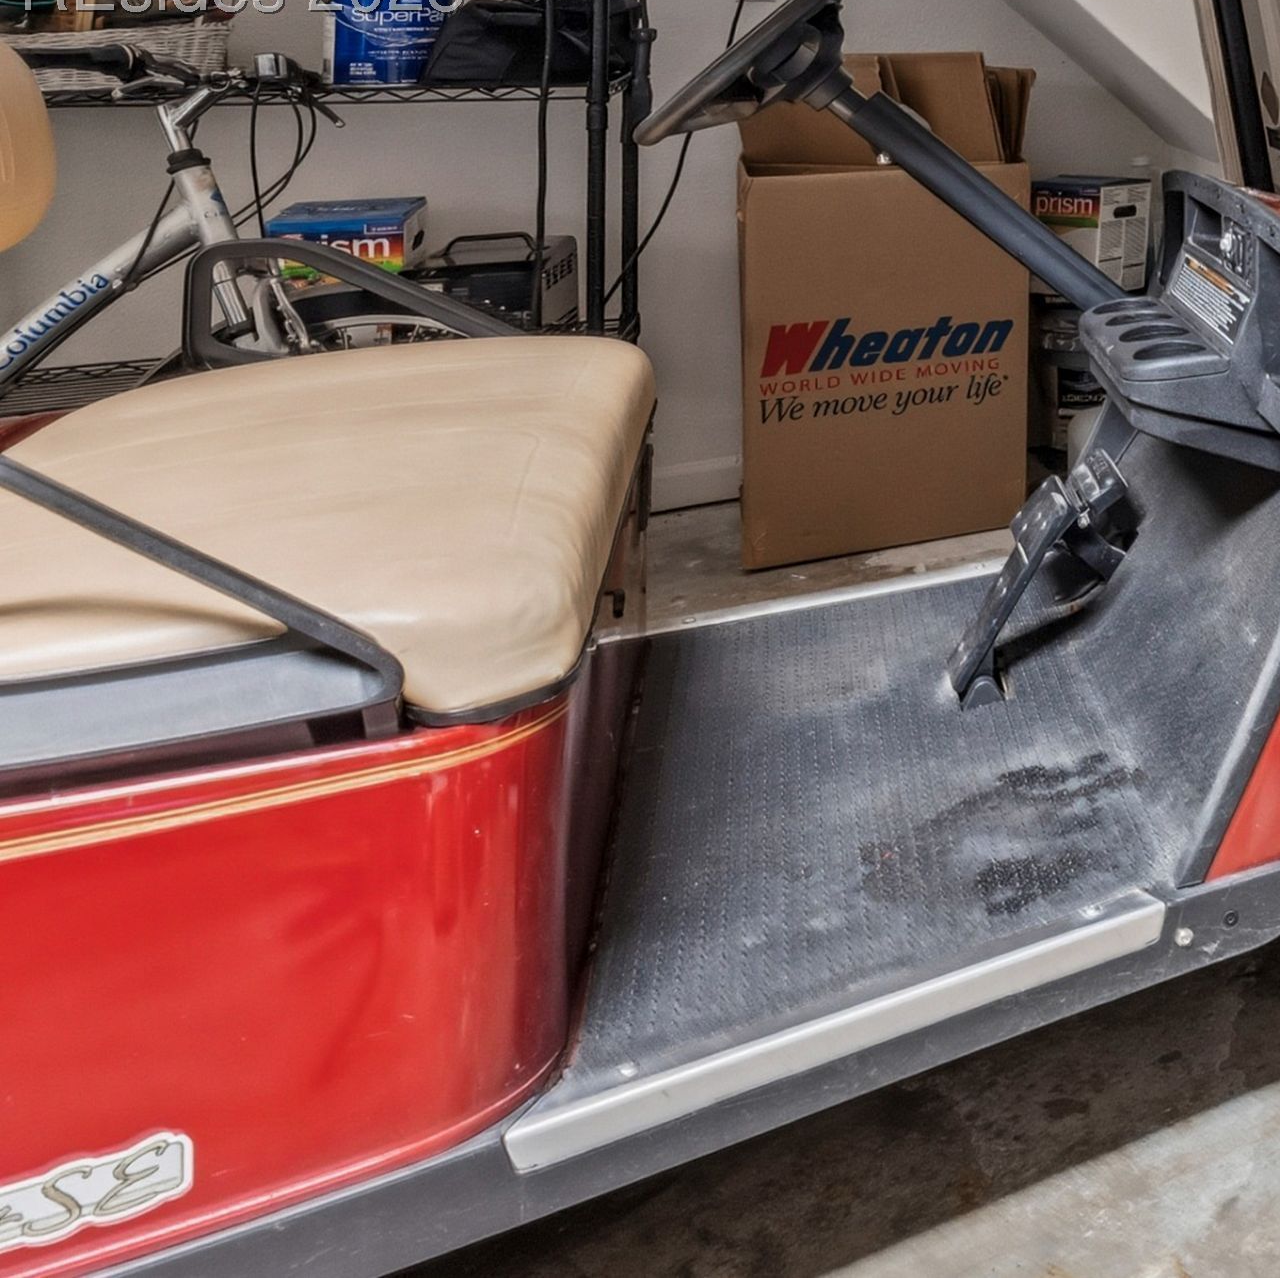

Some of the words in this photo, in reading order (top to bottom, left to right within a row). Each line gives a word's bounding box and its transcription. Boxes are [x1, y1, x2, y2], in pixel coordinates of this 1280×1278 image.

[1036, 191, 1094, 216] prism
[759, 316, 1014, 379] Wheaton
[759, 376, 841, 397] WORLD
[850, 369, 907, 387] WIDE
[915, 357, 1001, 379] MOVING
[759, 395, 806, 425] We
[812, 389, 888, 419] move
[891, 382, 960, 416] your
